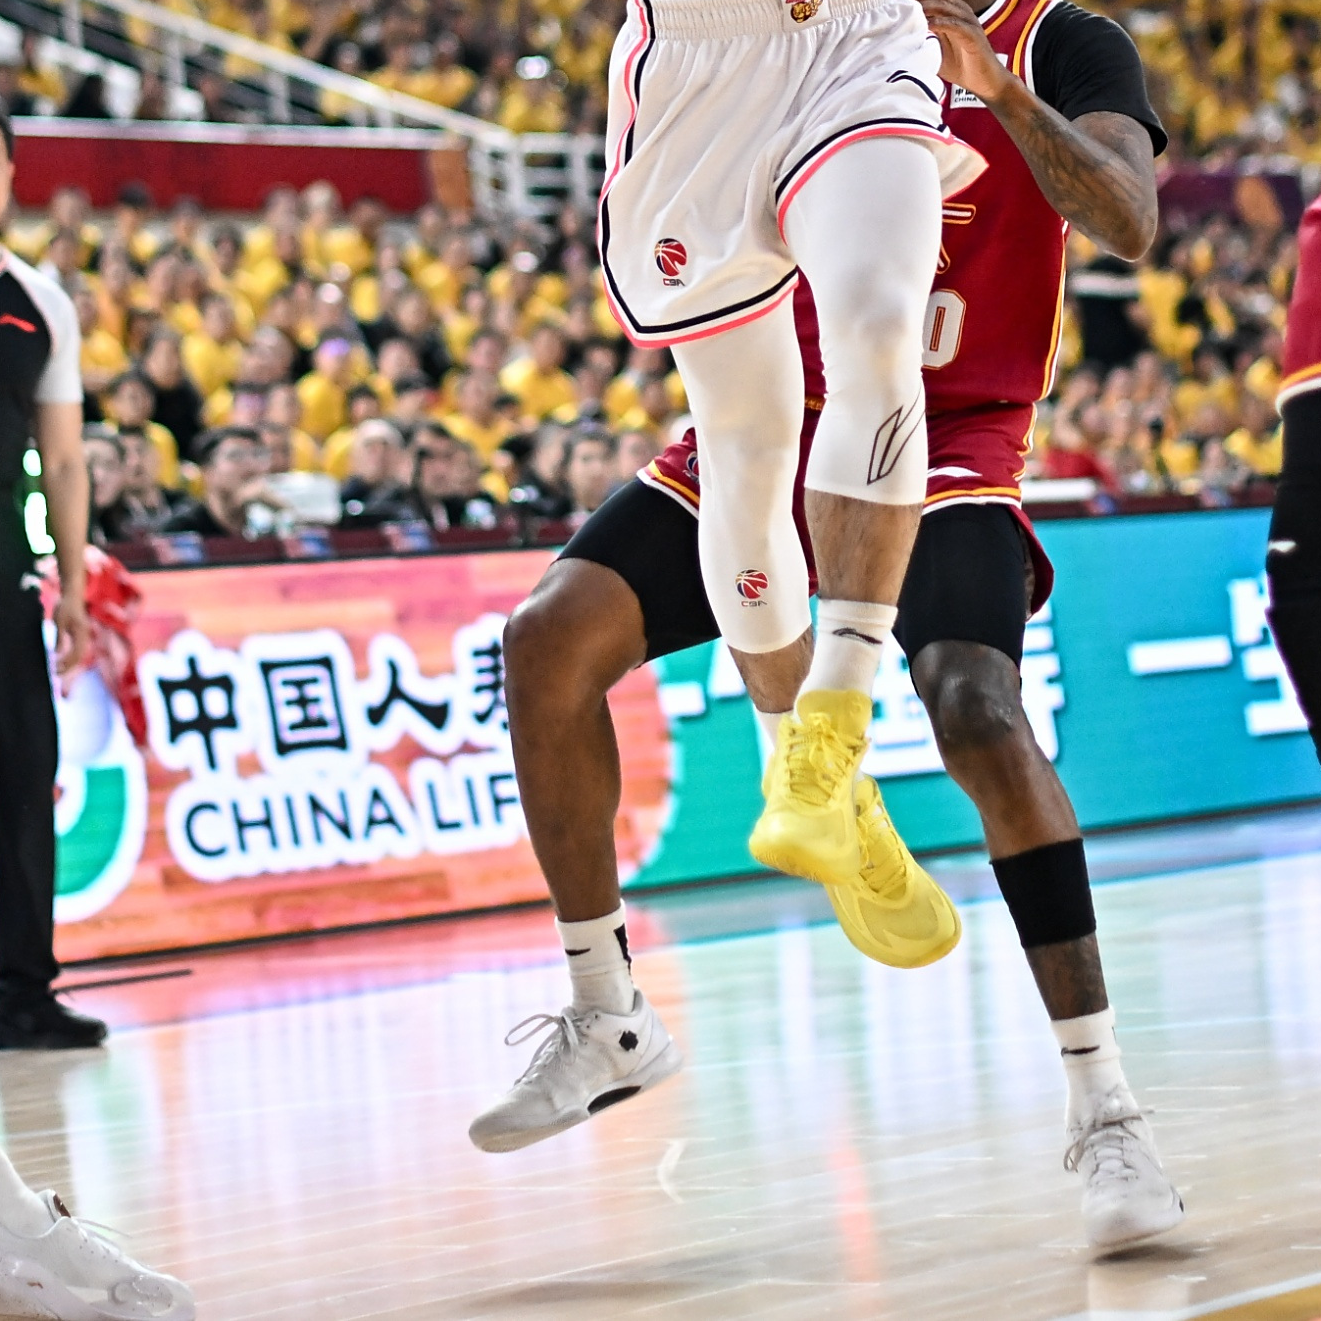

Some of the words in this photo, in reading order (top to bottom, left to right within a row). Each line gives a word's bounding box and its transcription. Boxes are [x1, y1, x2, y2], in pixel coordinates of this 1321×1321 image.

[663, 277, 686, 287] CBA
[184, 788, 406, 858] CHINA
[427, 774, 520, 831] LIF
